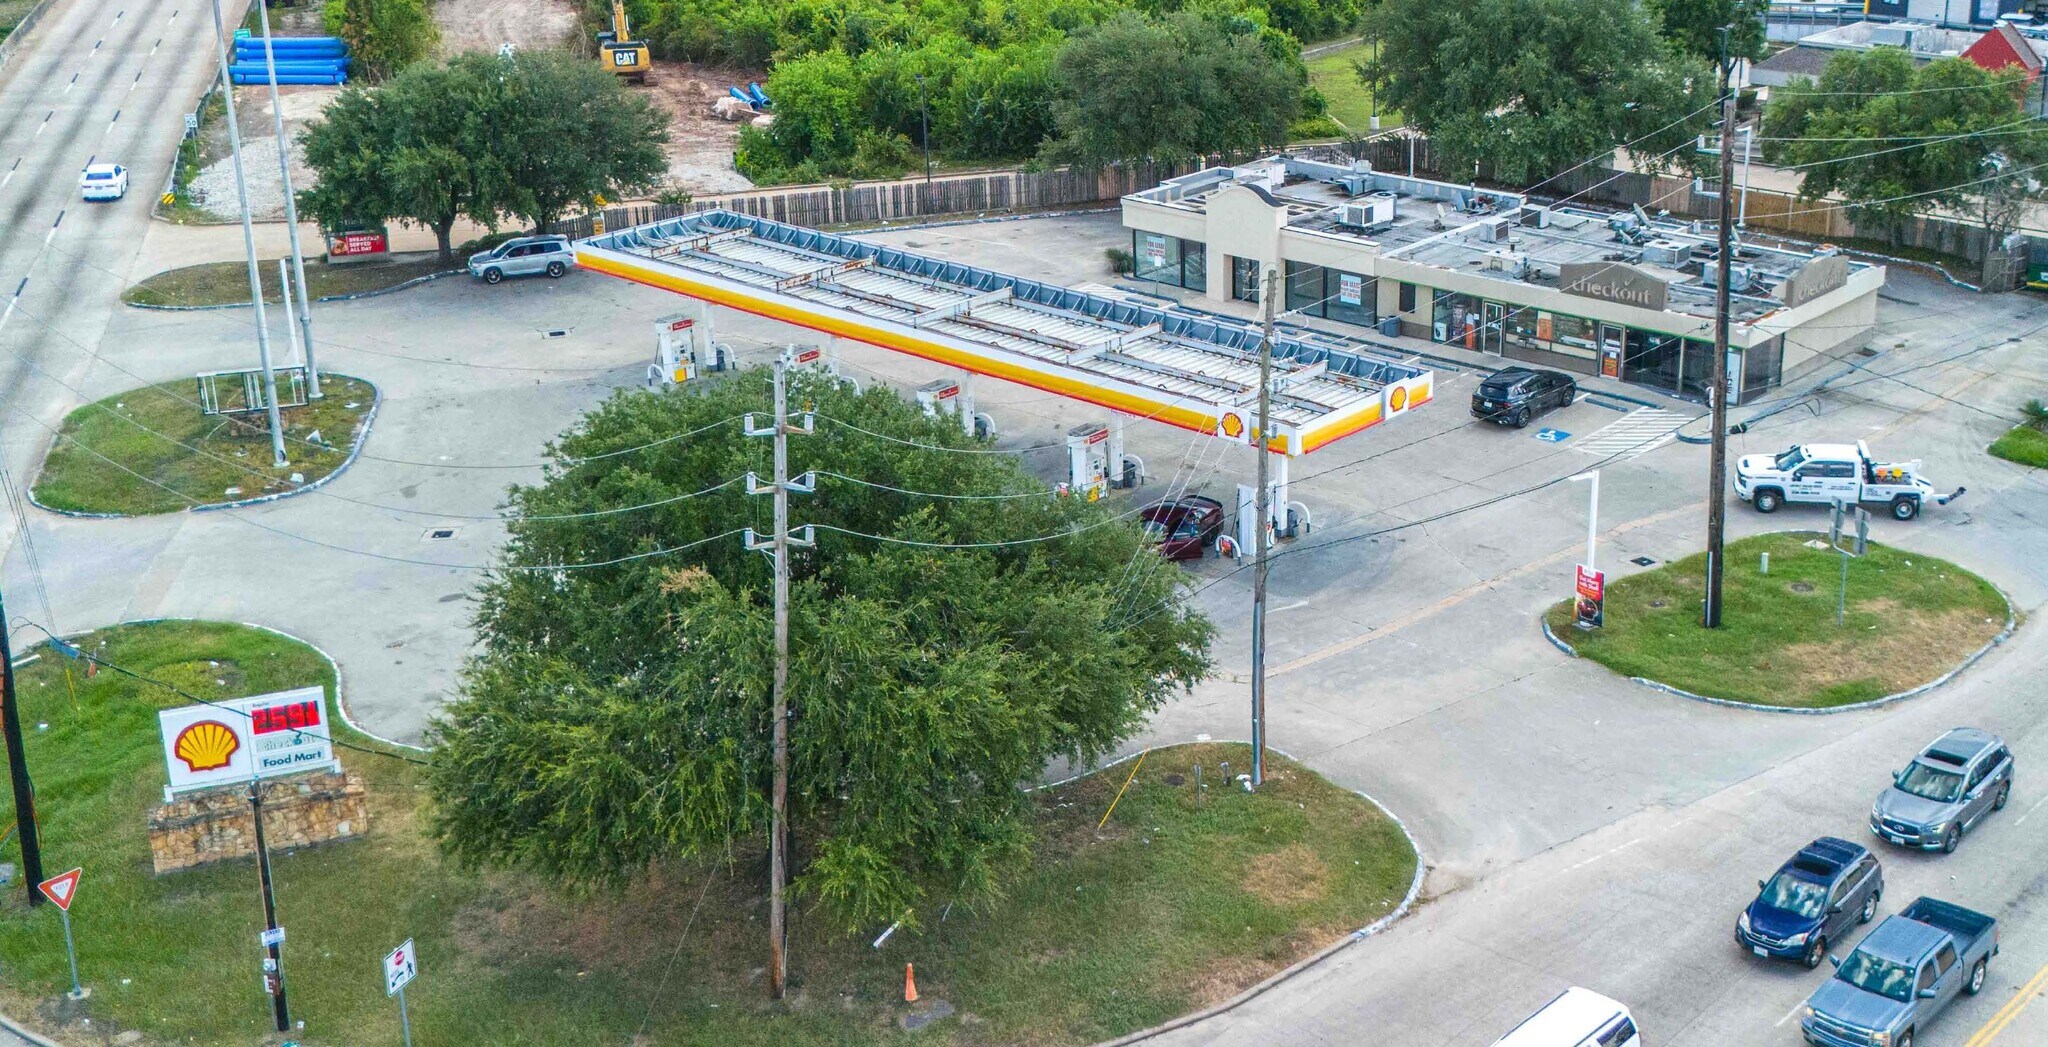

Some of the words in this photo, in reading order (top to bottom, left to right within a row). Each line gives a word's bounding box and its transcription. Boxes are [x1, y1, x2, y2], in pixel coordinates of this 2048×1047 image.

[615, 52, 636, 66] CAT
[1572, 275, 1651, 304] checkout
[264, 735, 316, 751] checkut
[263, 754, 292, 768] Food
[294, 751, 322, 762] Mart
